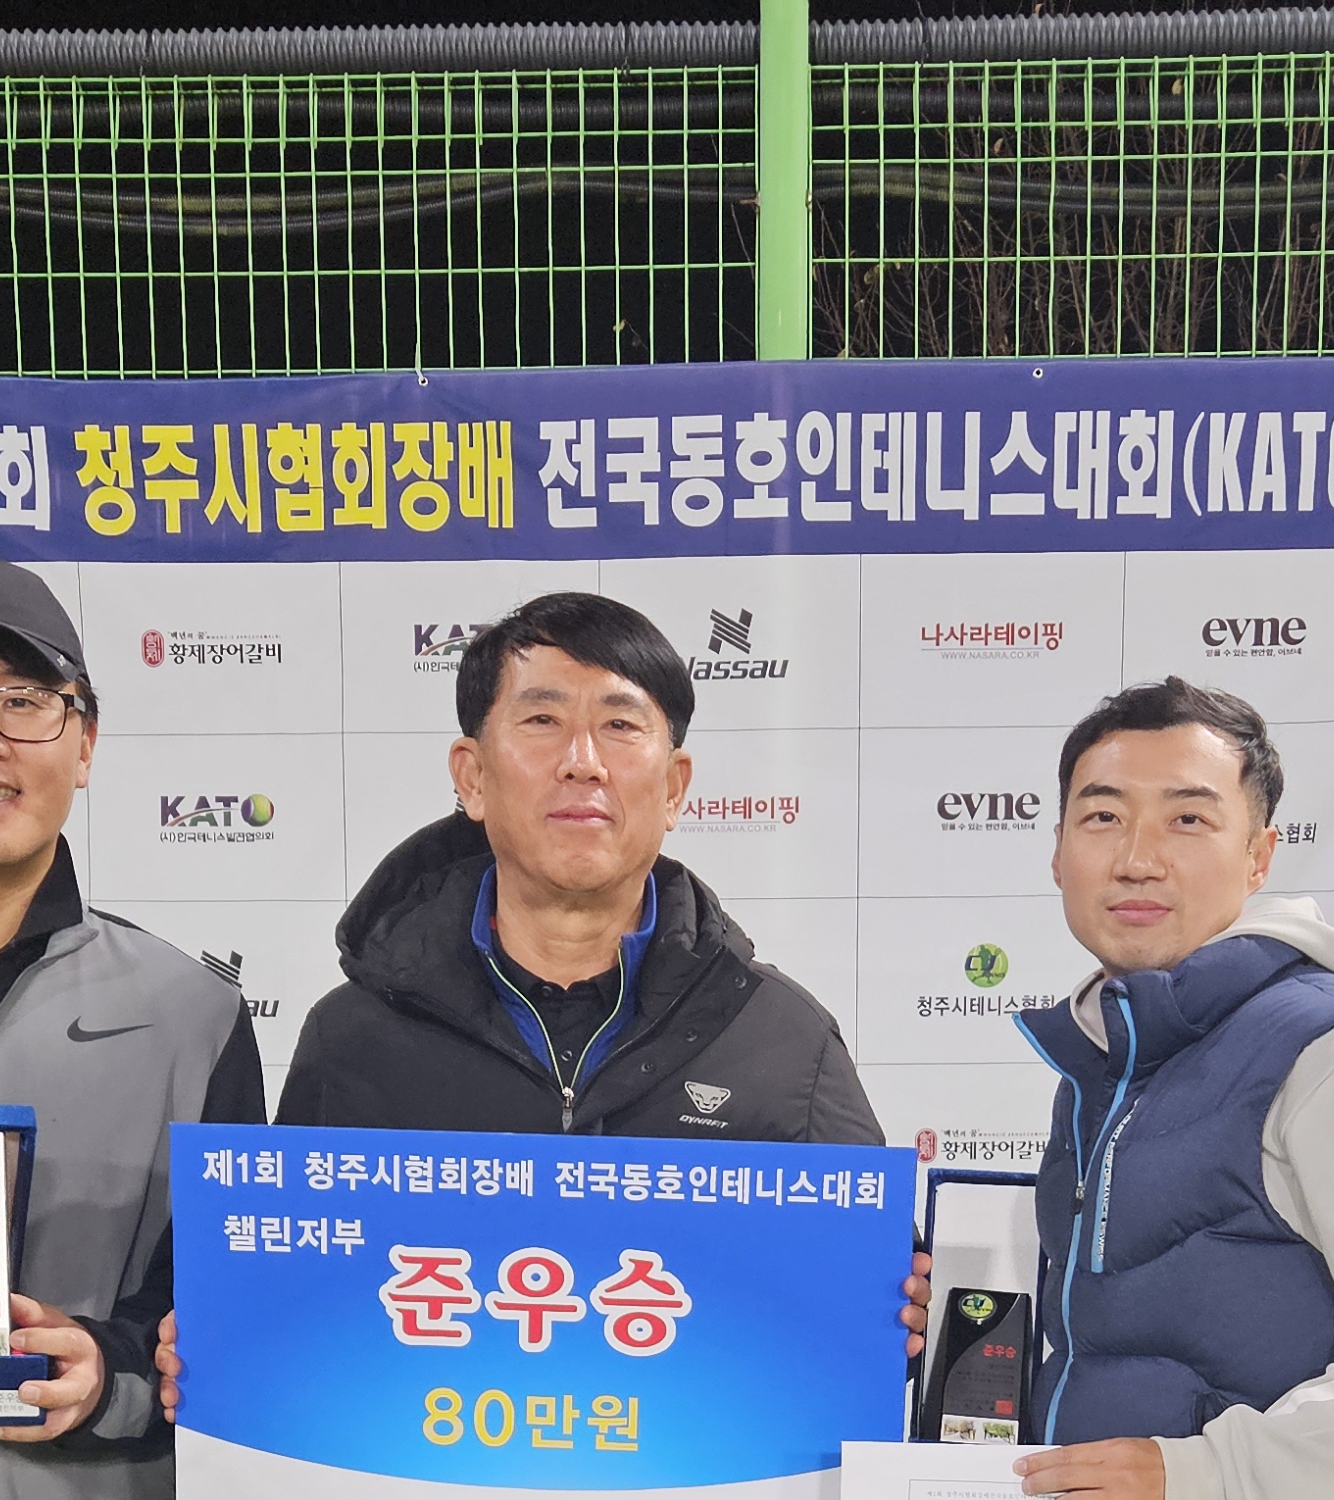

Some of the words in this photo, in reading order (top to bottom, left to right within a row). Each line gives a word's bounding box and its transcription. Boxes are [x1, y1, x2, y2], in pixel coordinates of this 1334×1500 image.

[74, 420, 516, 537] 청주시협회장배
[412, 624, 487, 656] KA
[921, 621, 1064, 651] 나사라테이핑
[1201, 617, 1307, 647] evne
[168, 643, 283, 665] 황제장어갈비
[941, 651, 1040, 660] WWW.NASARA.CO.KR
[682, 796, 800, 824] 사라테이핑
[937, 792, 1041, 821] evne
[679, 824, 777, 833] WWW.NASARA.CO.KR
[679, 1114, 729, 1129] DYNAFIT
[202, 1149, 284, 1189] 제1회
[303, 1150, 535, 1197] 청주시협회장배
[553, 1159, 885, 1210] 전국동호인테니스대회
[223, 1214, 366, 1256] 챌린저부
[378, 1243, 693, 1357] 준우승
[422, 1387, 642, 1453] 80만원
